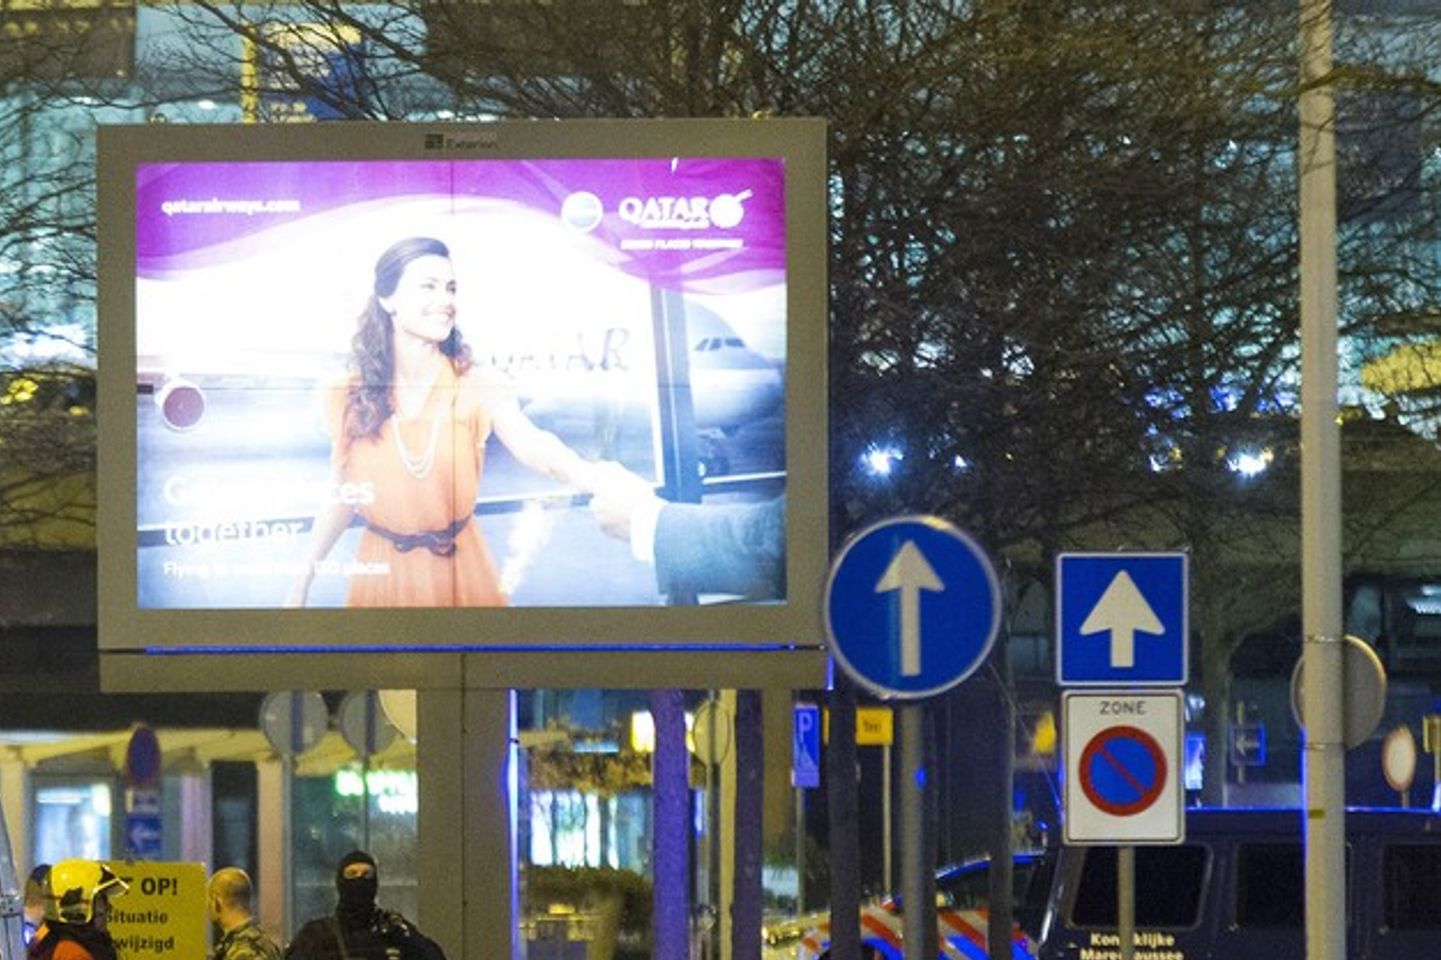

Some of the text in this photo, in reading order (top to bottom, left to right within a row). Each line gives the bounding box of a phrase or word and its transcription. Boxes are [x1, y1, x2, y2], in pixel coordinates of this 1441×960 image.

[618, 196, 710, 224] QATAR
[1099, 700, 1148, 715] ZONE
[799, 711, 814, 743] P
[141, 878, 178, 896] OP!
[113, 935, 175, 954] wijzigd
[1090, 931, 1175, 949] Konklijke
